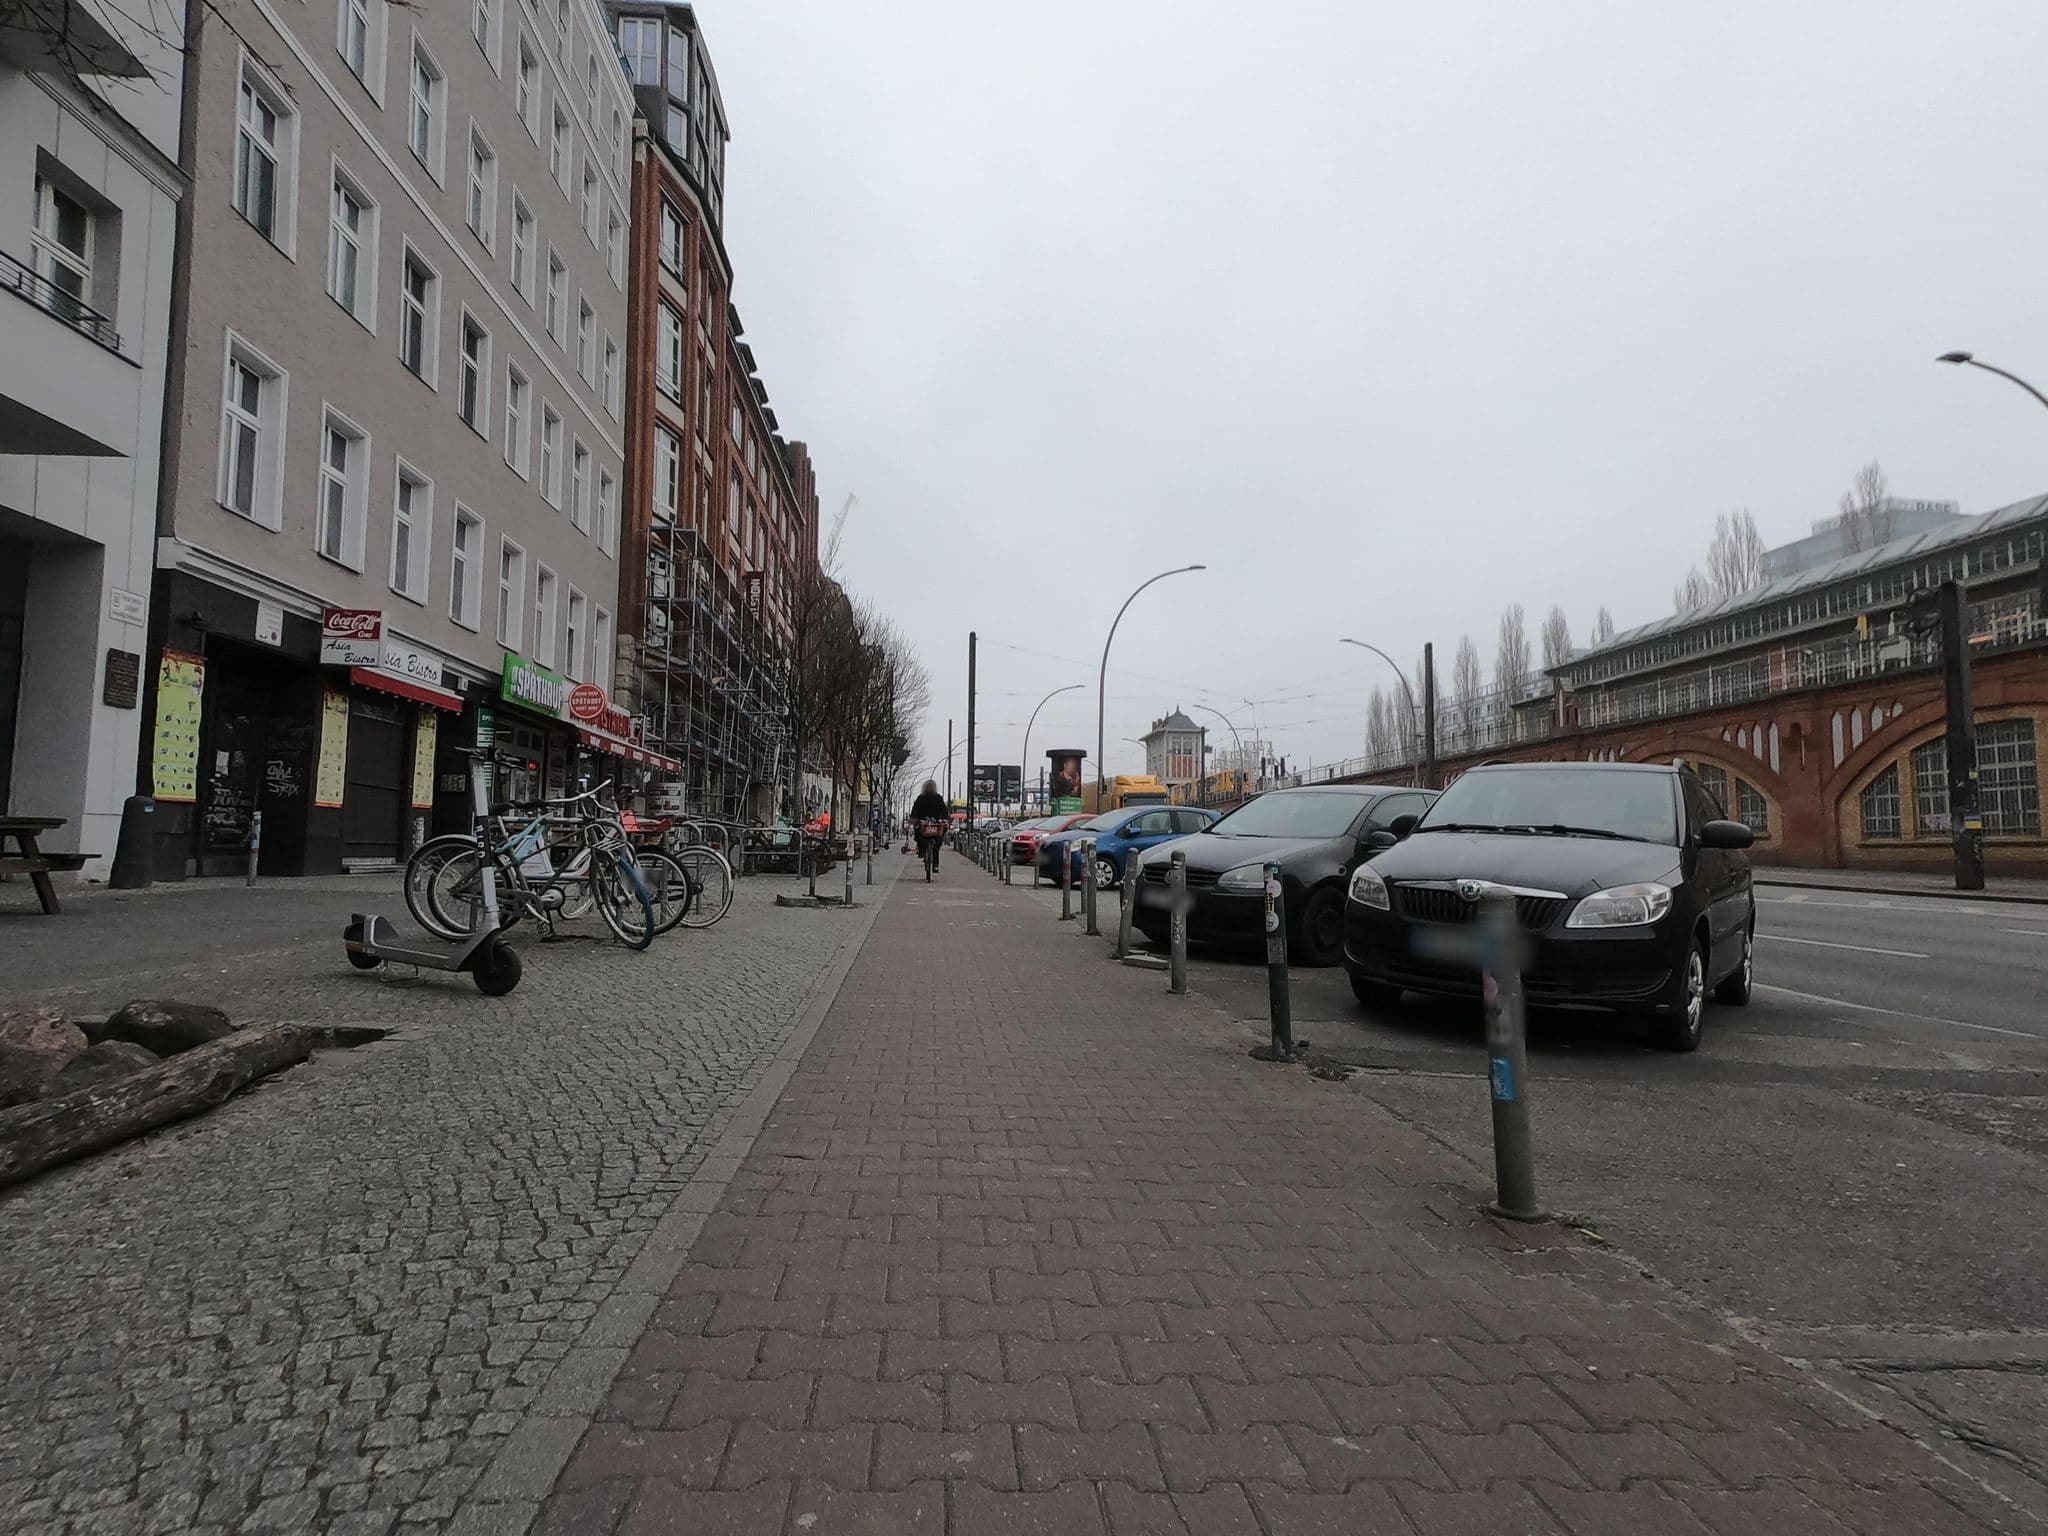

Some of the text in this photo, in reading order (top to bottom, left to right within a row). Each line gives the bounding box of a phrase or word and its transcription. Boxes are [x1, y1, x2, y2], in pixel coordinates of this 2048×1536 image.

[324, 638, 352, 651] Asia
[343, 652, 376, 664] Bistro
[384, 651, 438, 681] sia Bistro
